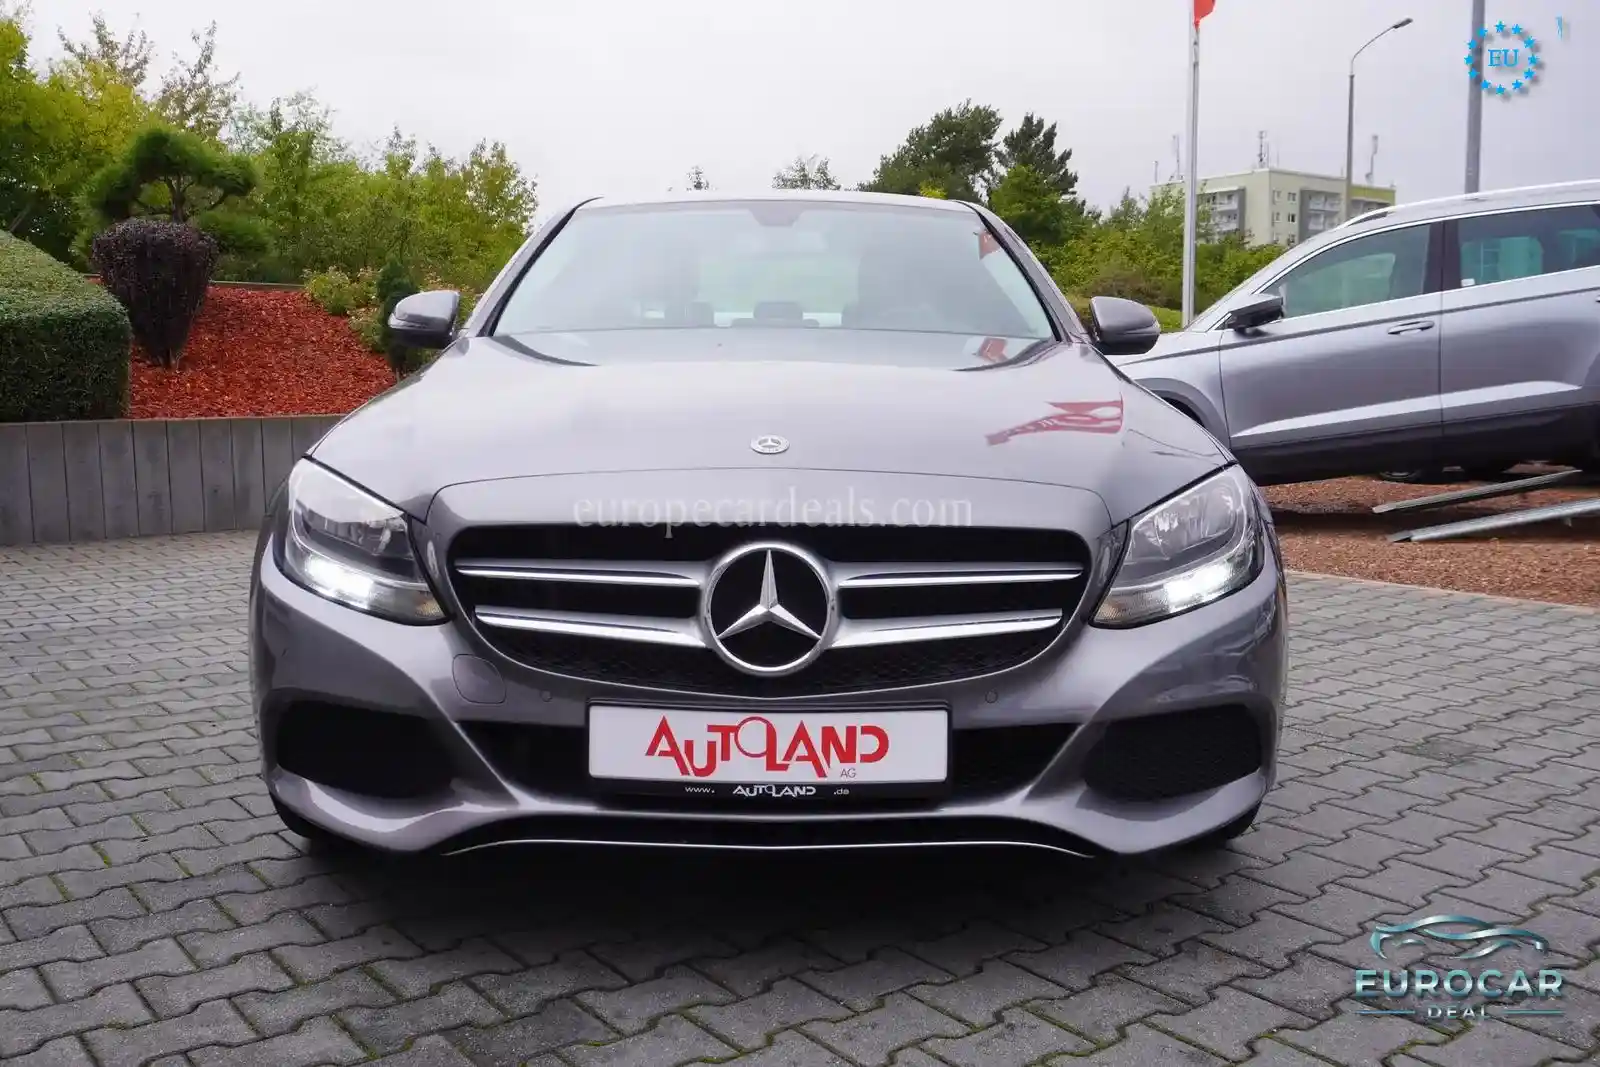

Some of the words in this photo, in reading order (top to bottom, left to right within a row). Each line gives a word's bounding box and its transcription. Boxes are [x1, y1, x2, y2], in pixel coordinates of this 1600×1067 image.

[840, 768, 857, 779] AG
[684, 786, 716, 794] www.
[833, 787, 850, 796] .de
